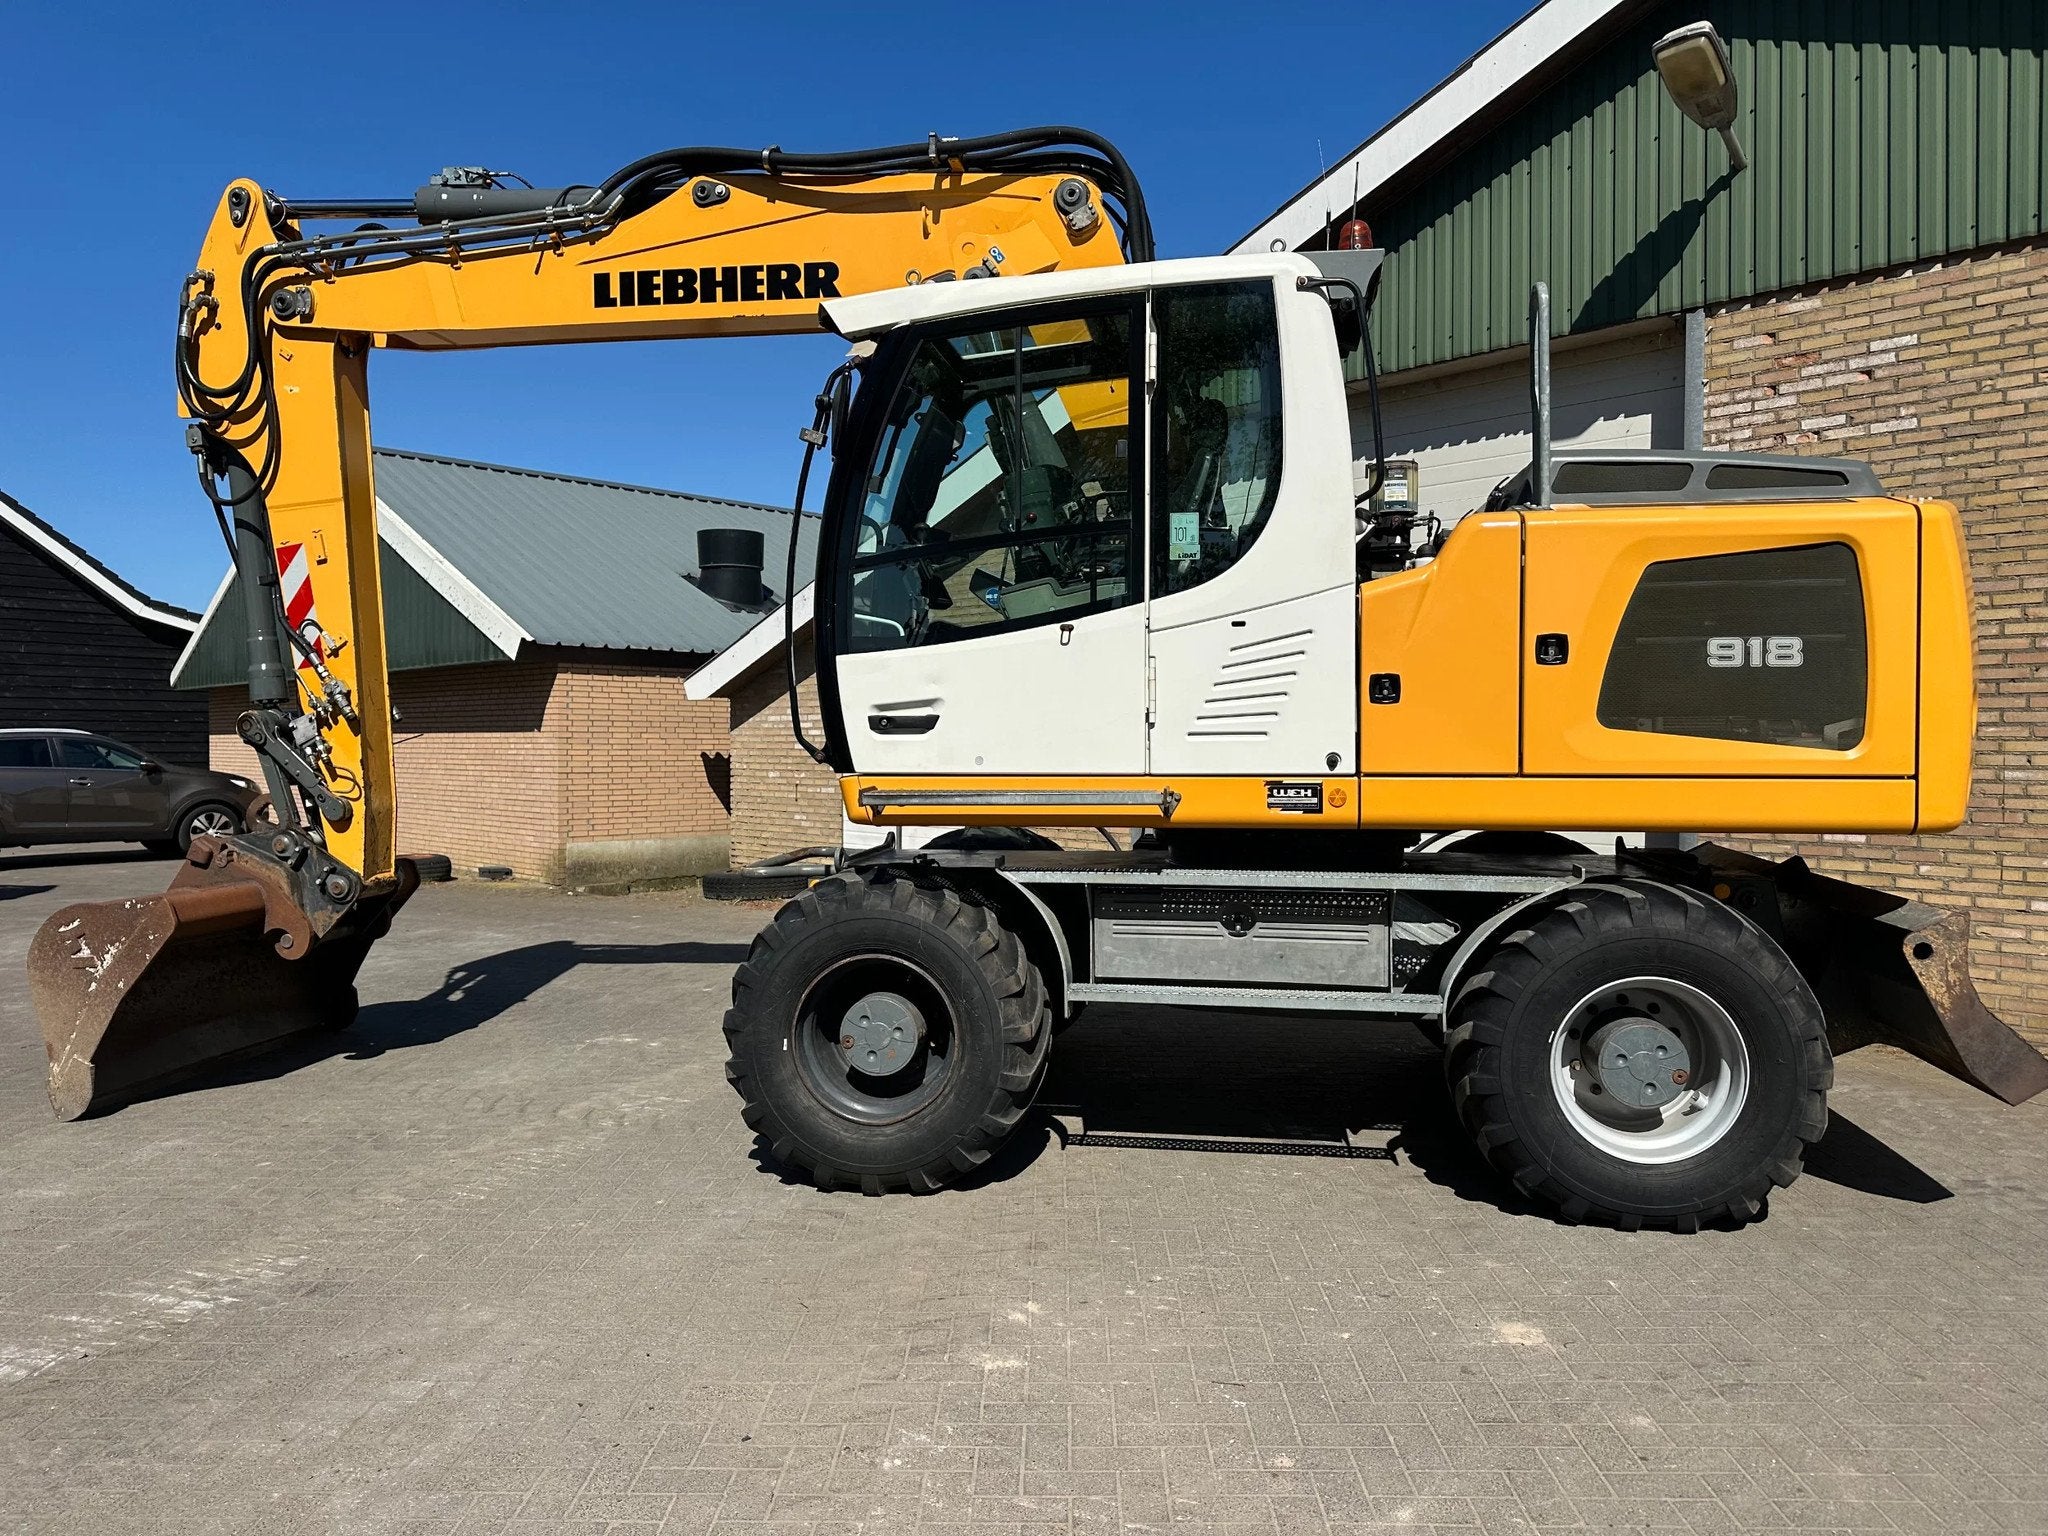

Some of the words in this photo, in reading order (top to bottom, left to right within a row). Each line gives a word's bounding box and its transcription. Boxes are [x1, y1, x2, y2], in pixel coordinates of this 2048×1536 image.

[594, 261, 842, 309] LIEBHERR
[1174, 526, 1187, 542] 101
[1707, 637, 1804, 667] 918
